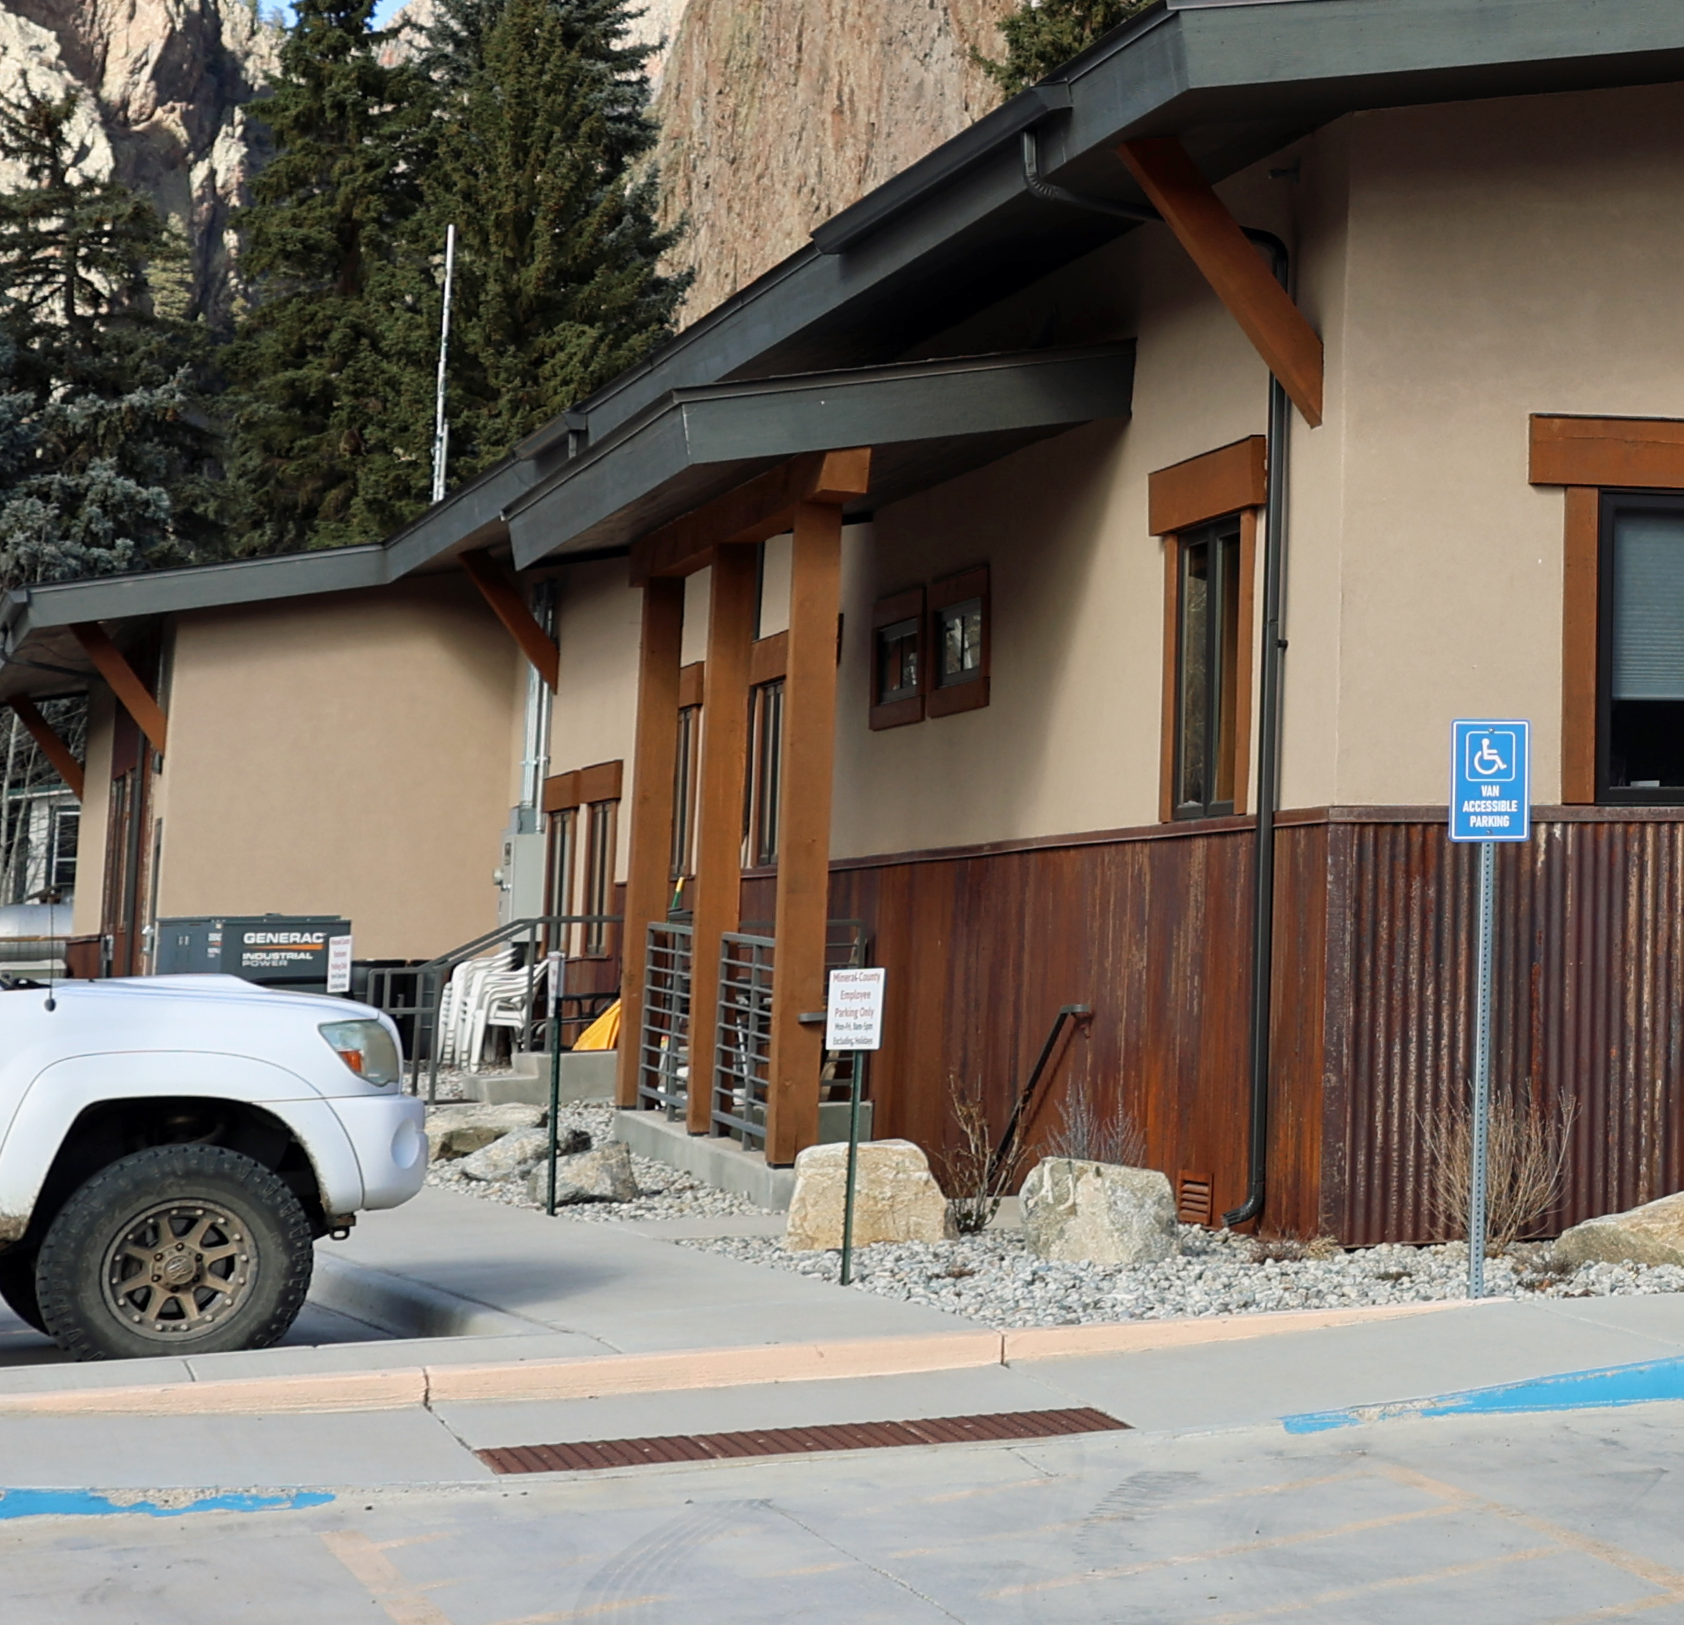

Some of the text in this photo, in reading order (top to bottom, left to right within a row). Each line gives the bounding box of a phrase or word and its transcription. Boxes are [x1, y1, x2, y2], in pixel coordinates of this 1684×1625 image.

[1481, 785, 1500, 797] VAN
[1462, 800, 1518, 812] ACCESSIBLE
[1470, 815, 1510, 827] PARKING
[243, 932, 325, 944] GENERAC
[242, 952, 313, 960] INDUSTRIAL
[832, 971, 881, 984] Mineral County
[840, 989, 871, 1002] Employee
[834, 1007, 875, 1019] Parking Only
